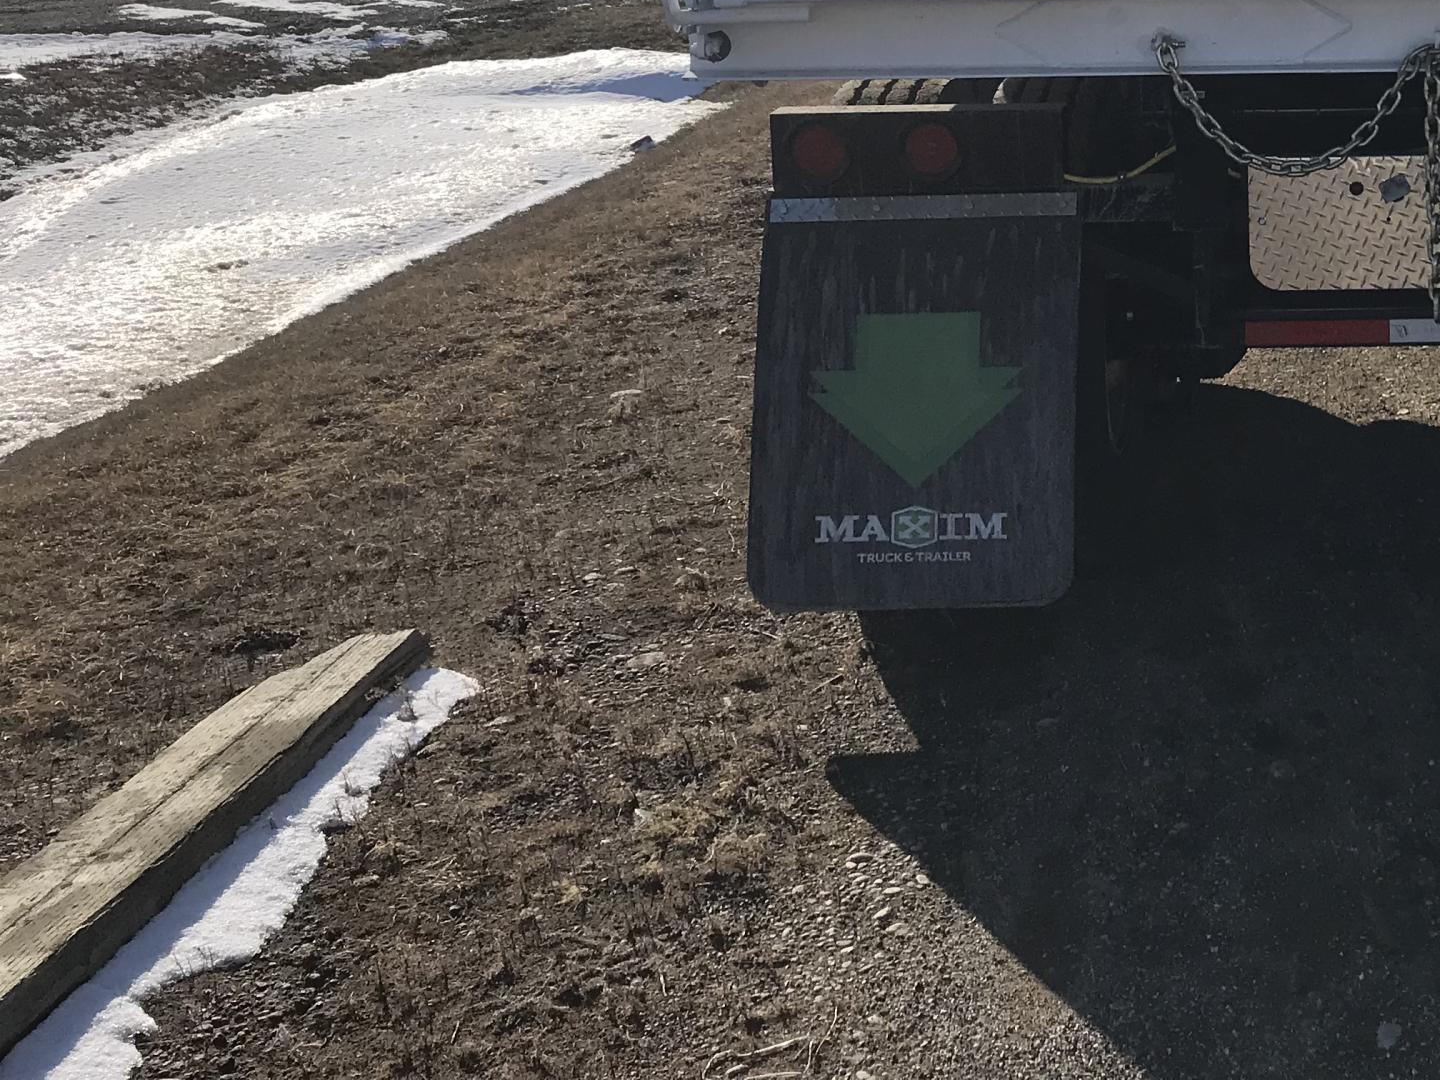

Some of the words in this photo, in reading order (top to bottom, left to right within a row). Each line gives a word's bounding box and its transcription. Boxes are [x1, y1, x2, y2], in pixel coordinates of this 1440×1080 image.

[814, 512, 1008, 543] MAXIM
[857, 553, 902, 563] TRUCK
[904, 553, 914, 562] &
[916, 551, 971, 562] TRAILER
